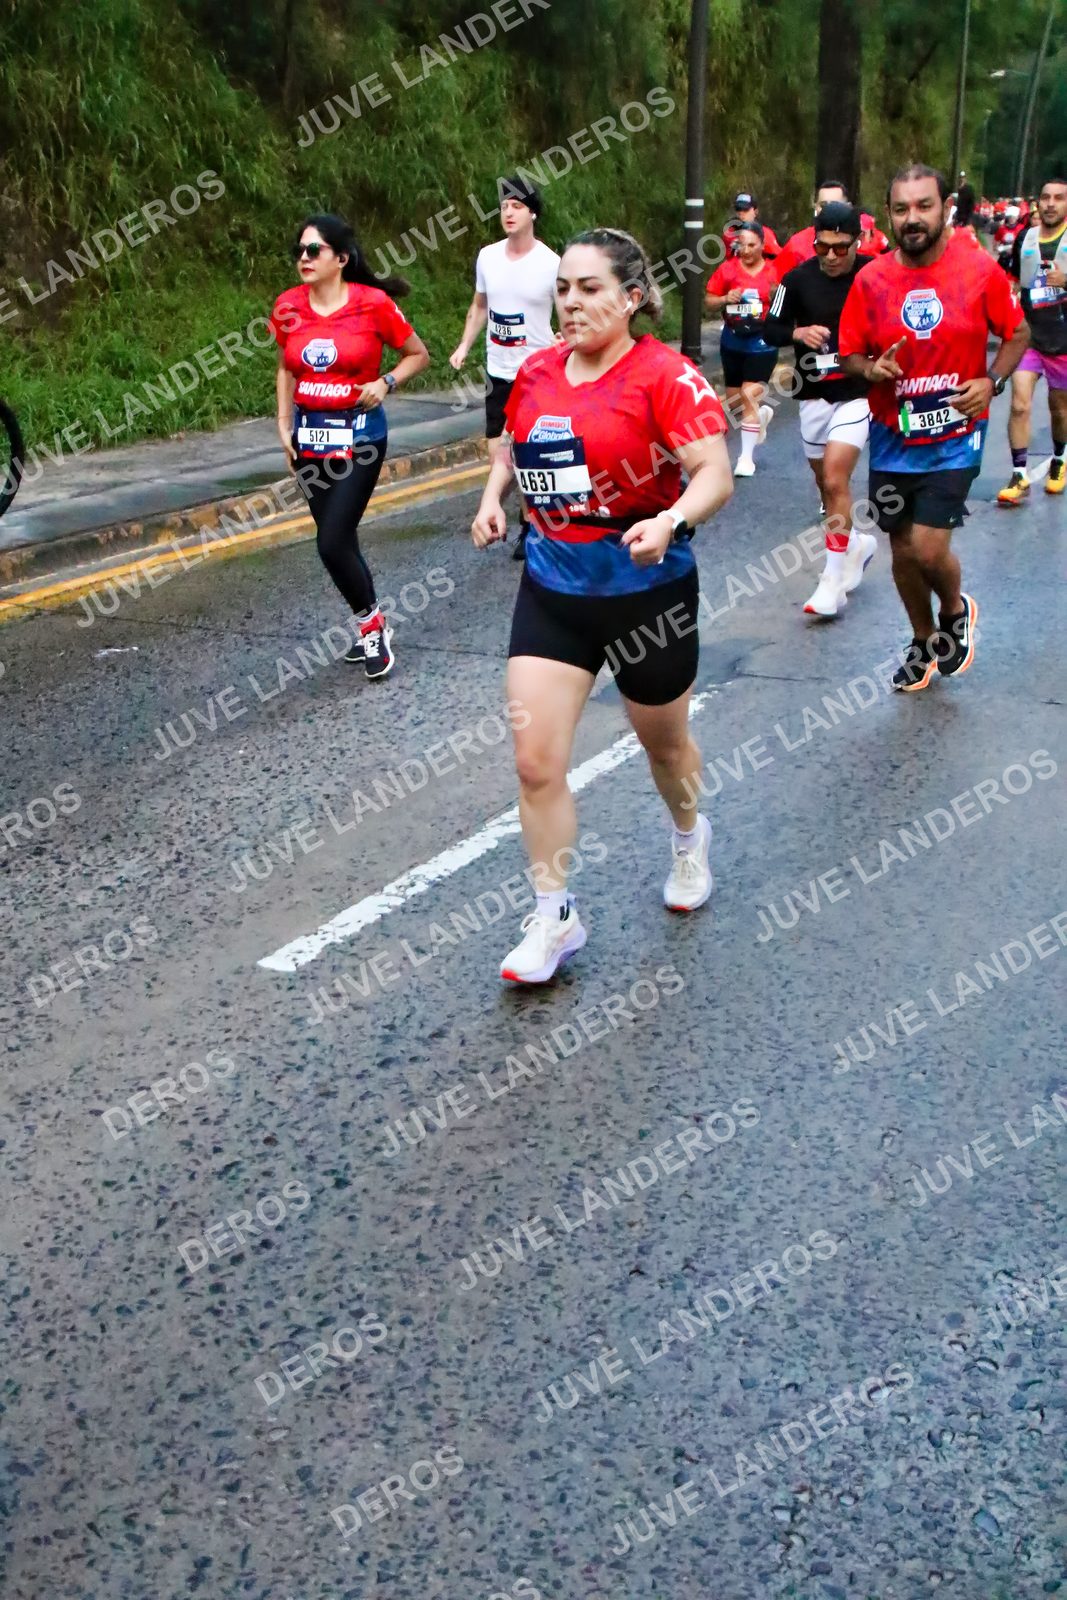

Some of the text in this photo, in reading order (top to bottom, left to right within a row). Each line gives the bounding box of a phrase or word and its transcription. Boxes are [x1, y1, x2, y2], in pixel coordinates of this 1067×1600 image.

[298, 381, 351, 397] SANTIAGO
[895, 373, 959, 396] SANTIAGO
[918, 408, 951, 428] 3842
[309, 430, 330, 442] 5121
[519, 471, 556, 492] 4637
